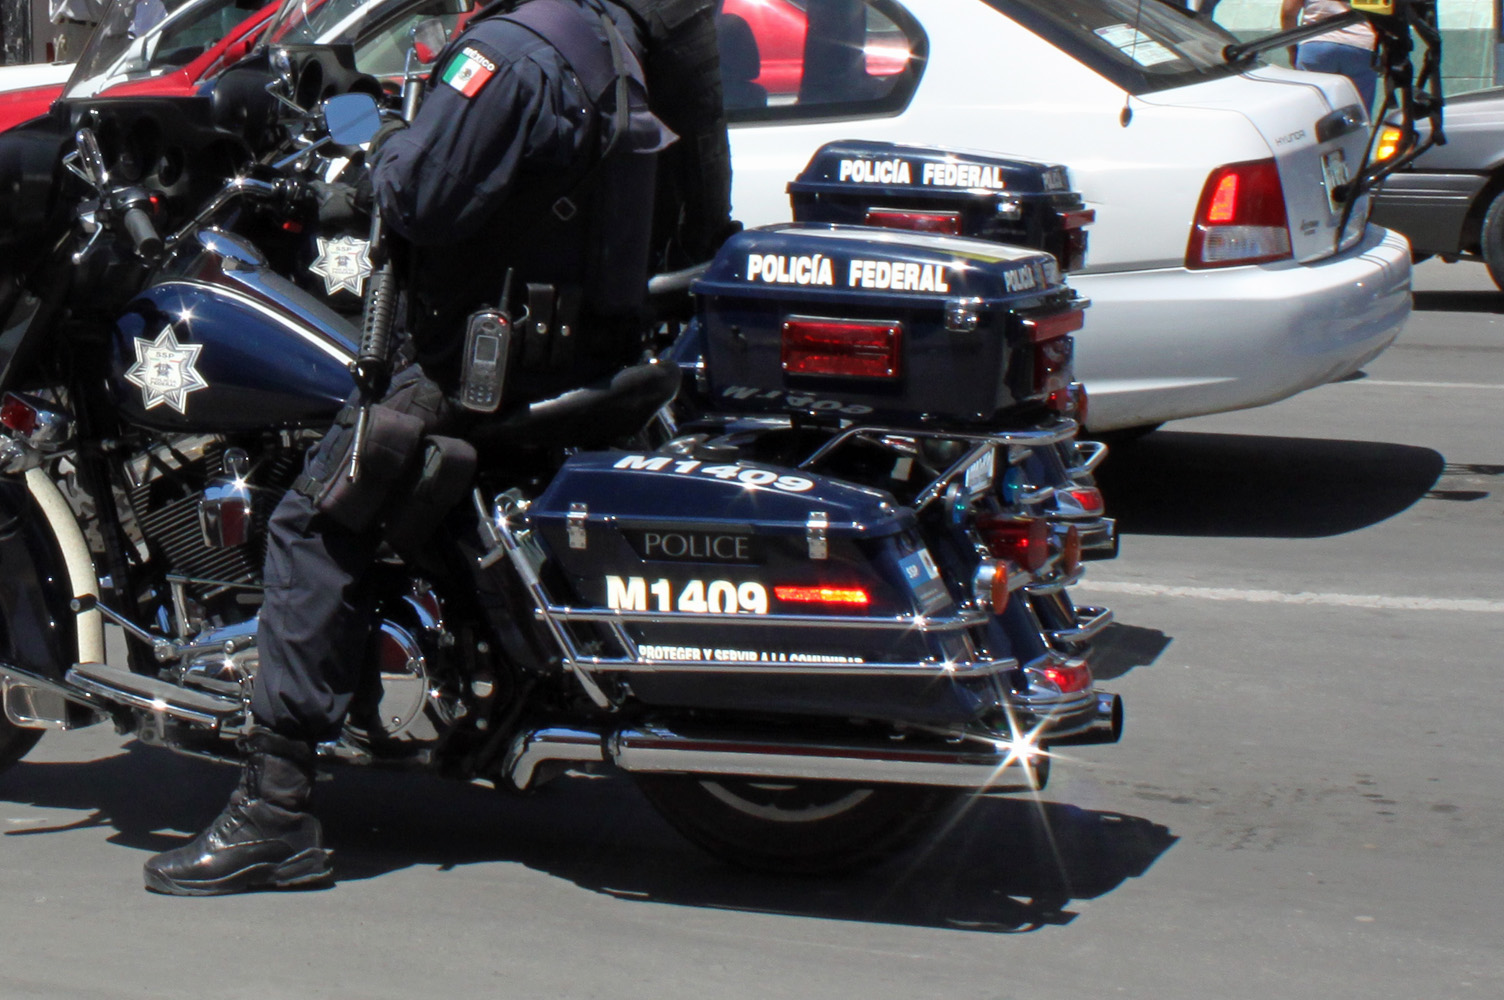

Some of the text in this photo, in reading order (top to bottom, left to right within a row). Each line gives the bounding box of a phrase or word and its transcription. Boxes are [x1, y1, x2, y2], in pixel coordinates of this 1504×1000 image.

[839, 158, 1005, 190] POLICÍA FEDERAL
[746, 253, 950, 294] POLICÍA FEDERAL
[613, 454, 814, 492] M1409
[645, 532, 750, 560] POLICE
[604, 574, 768, 615] M1409
[638, 644, 701, 661] PROTEGER
[702, 648, 713, 661] Y
